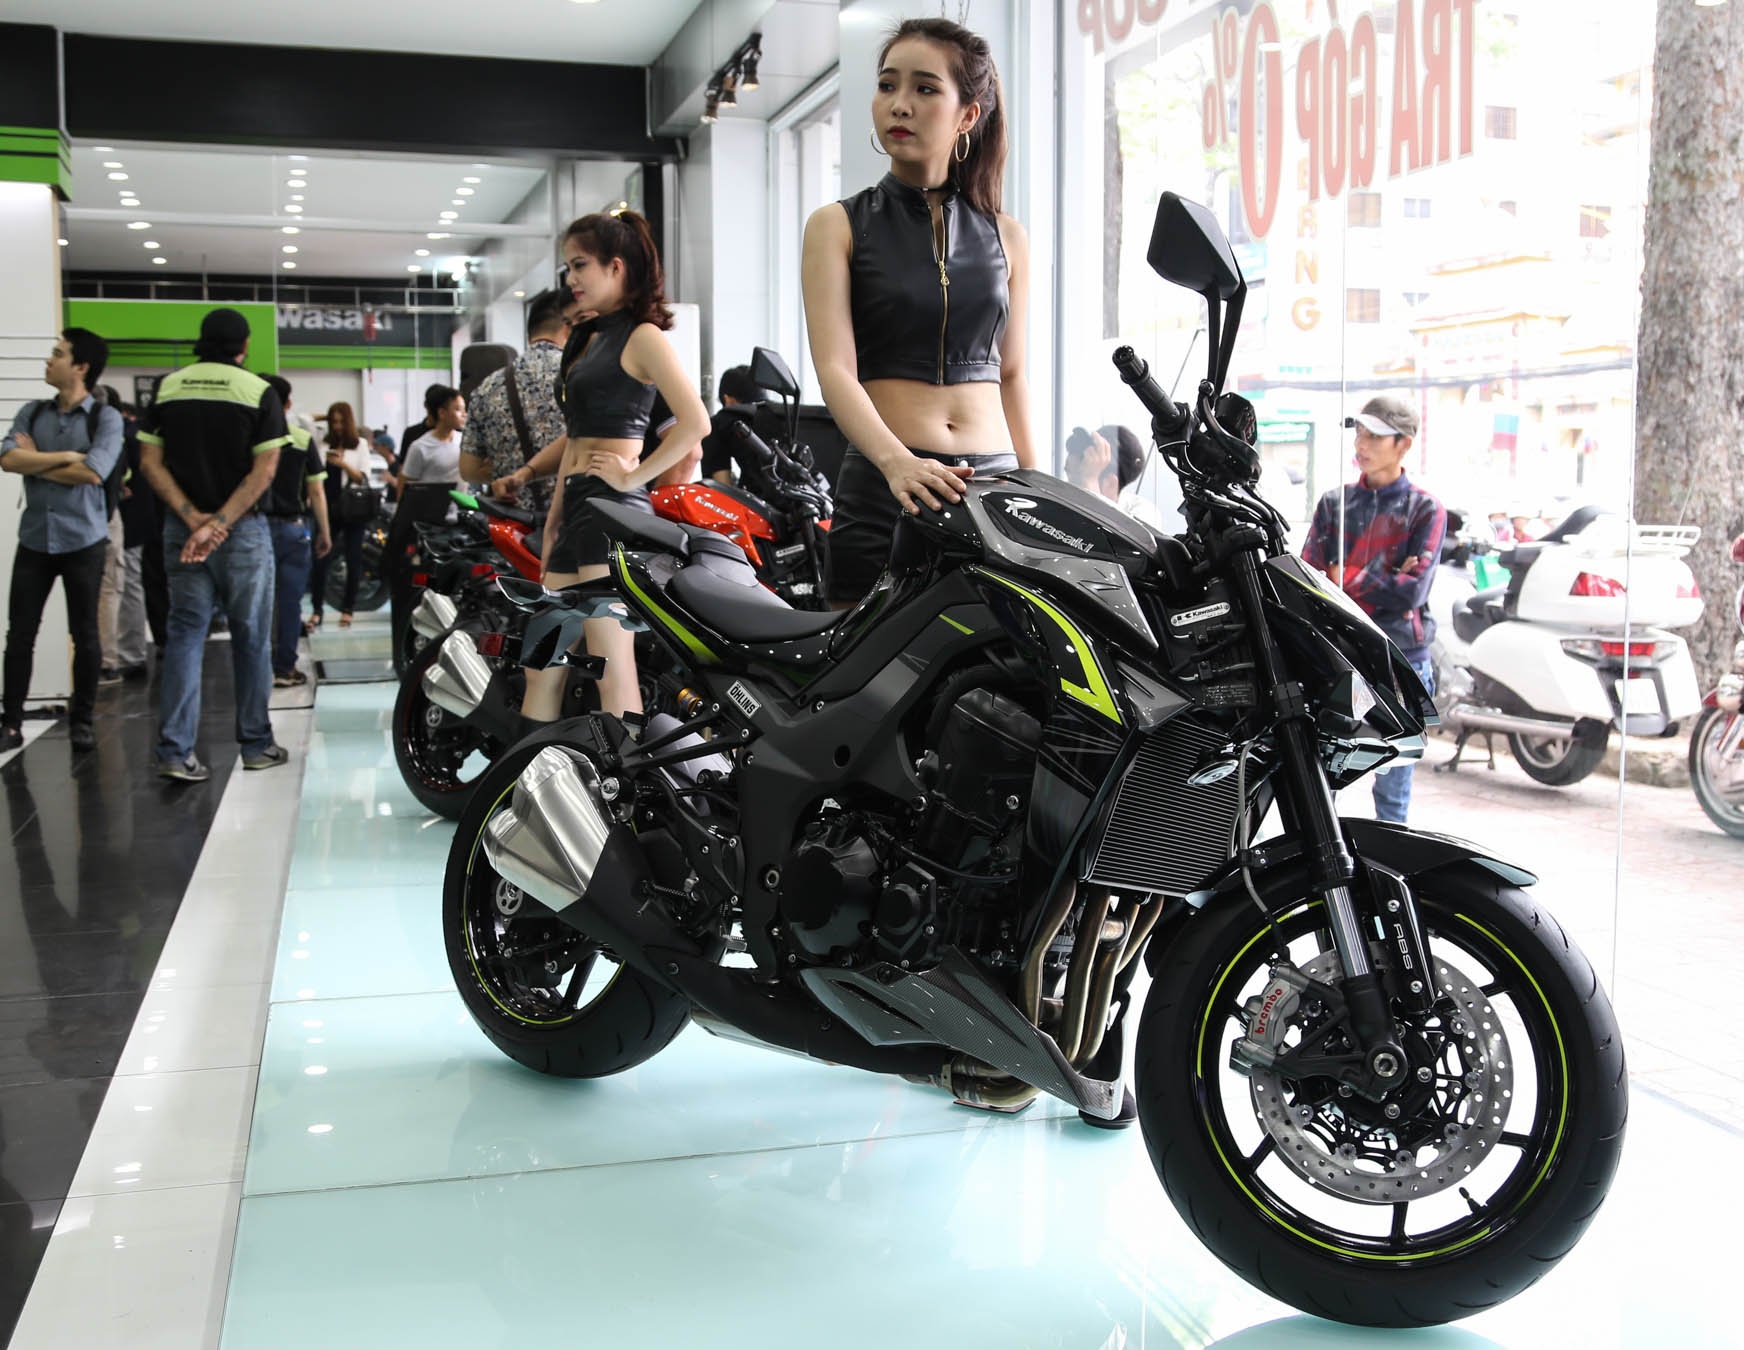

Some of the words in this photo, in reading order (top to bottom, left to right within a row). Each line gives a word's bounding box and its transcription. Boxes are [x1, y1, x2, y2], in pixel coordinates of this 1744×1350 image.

[1004, 497, 1094, 553] Kawasaki
[1192, 604, 1223, 617] Kawasaki
[730, 683, 756, 714] ÖHLINS
[1393, 923, 1413, 970] ABS
[1255, 988, 1283, 1034] brembo
